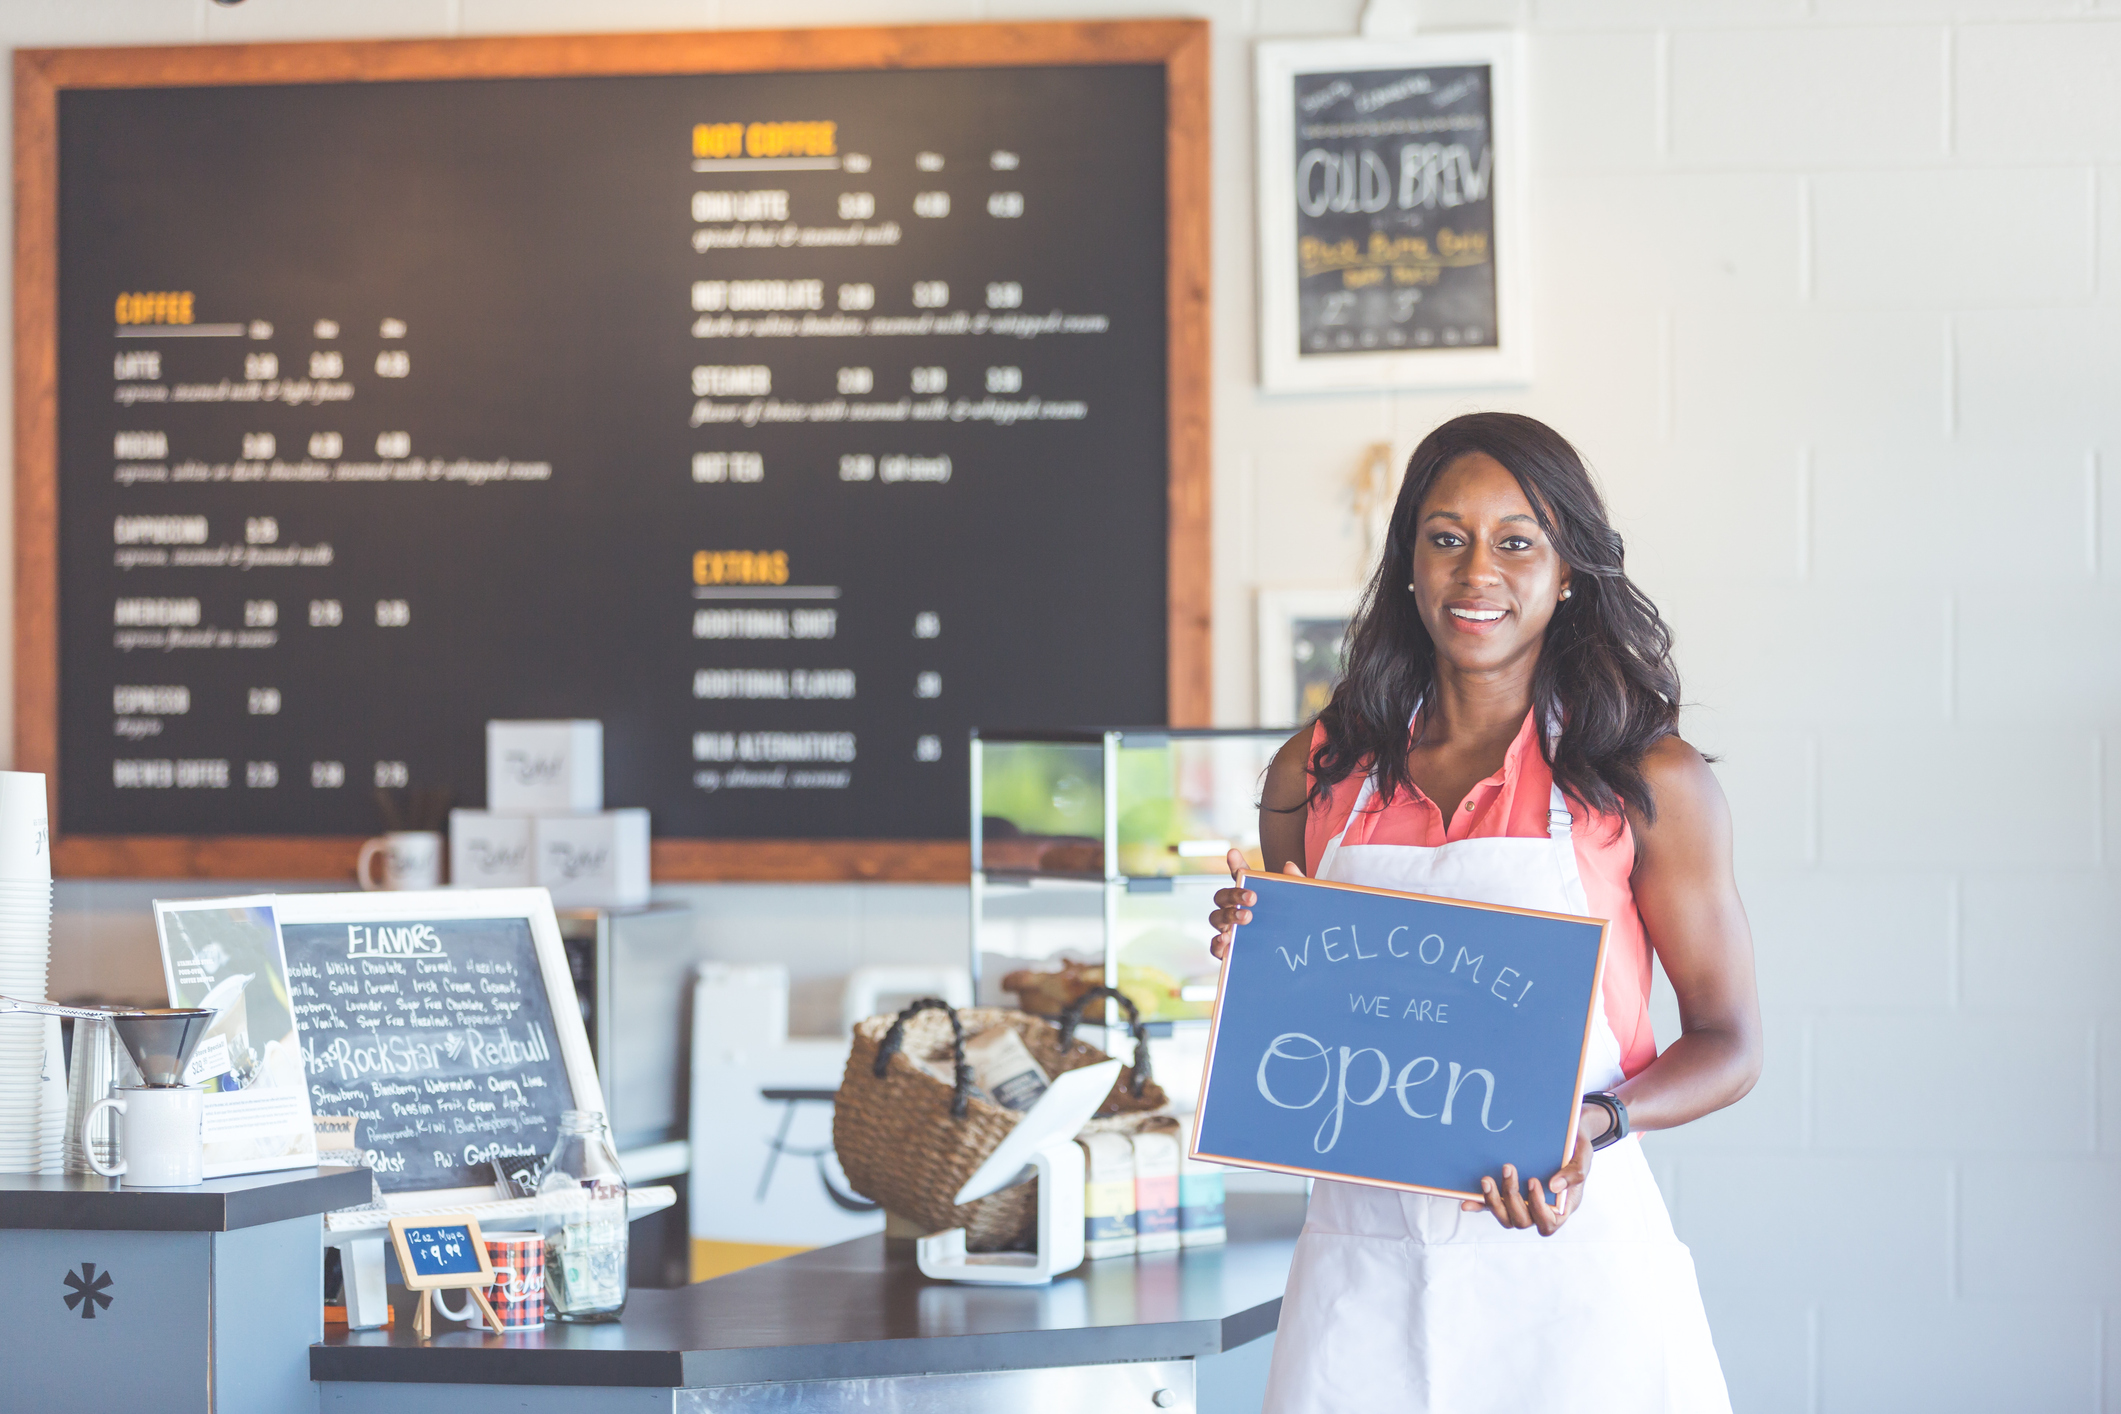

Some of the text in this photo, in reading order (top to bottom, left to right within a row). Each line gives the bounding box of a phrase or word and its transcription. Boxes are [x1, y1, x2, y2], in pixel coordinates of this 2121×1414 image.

[692, 120, 838, 158] HOT COFFEE
[1296, 141, 1495, 218] COLD BREW
[736, 189, 790, 221] LATTE
[115, 291, 195, 324] COFFEE
[728, 278, 824, 311] CHOCOLATE
[691, 365, 772, 396] STEAMER
[693, 549, 790, 586] EXTRAS
[692, 608, 838, 639] ADDITIONAL SHOT
[113, 685, 190, 714] ESPRESSO
[692, 668, 857, 700] ADDITIONAL FLAVOR
[692, 731, 857, 762] MILK ALTERNATIVES
[113, 759, 173, 788] BREWED
[175, 759, 230, 788] COFFEE
[348, 923, 442, 956] FLAVORS
[287, 961, 321, 979] ocolate,
[325, 961, 357, 976] White
[1275, 924, 1534, 1008] WELCOME!
[328, 980, 359, 996] Salted
[412, 979, 439, 993] Irish
[294, 1002, 337, 1020] aspberry,
[396, 997, 421, 1015] Sugar
[423, 996, 443, 1010] Free
[491, 997, 521, 1020] Sugar
[356, 1014, 381, 1034] Sugar
[385, 1013, 405, 1027] Free
[1349, 993, 1449, 1024] WE ARE
[466, 1021, 550, 1069] Redbull
[488, 1076, 522, 1101] Cherry
[1256, 1032, 1513, 1154] Open
[391, 1101, 434, 1118] Passion
[466, 1097, 496, 1113] Green
[453, 1116, 477, 1134] Blue
[437, 1229, 466, 1245] Mugs
